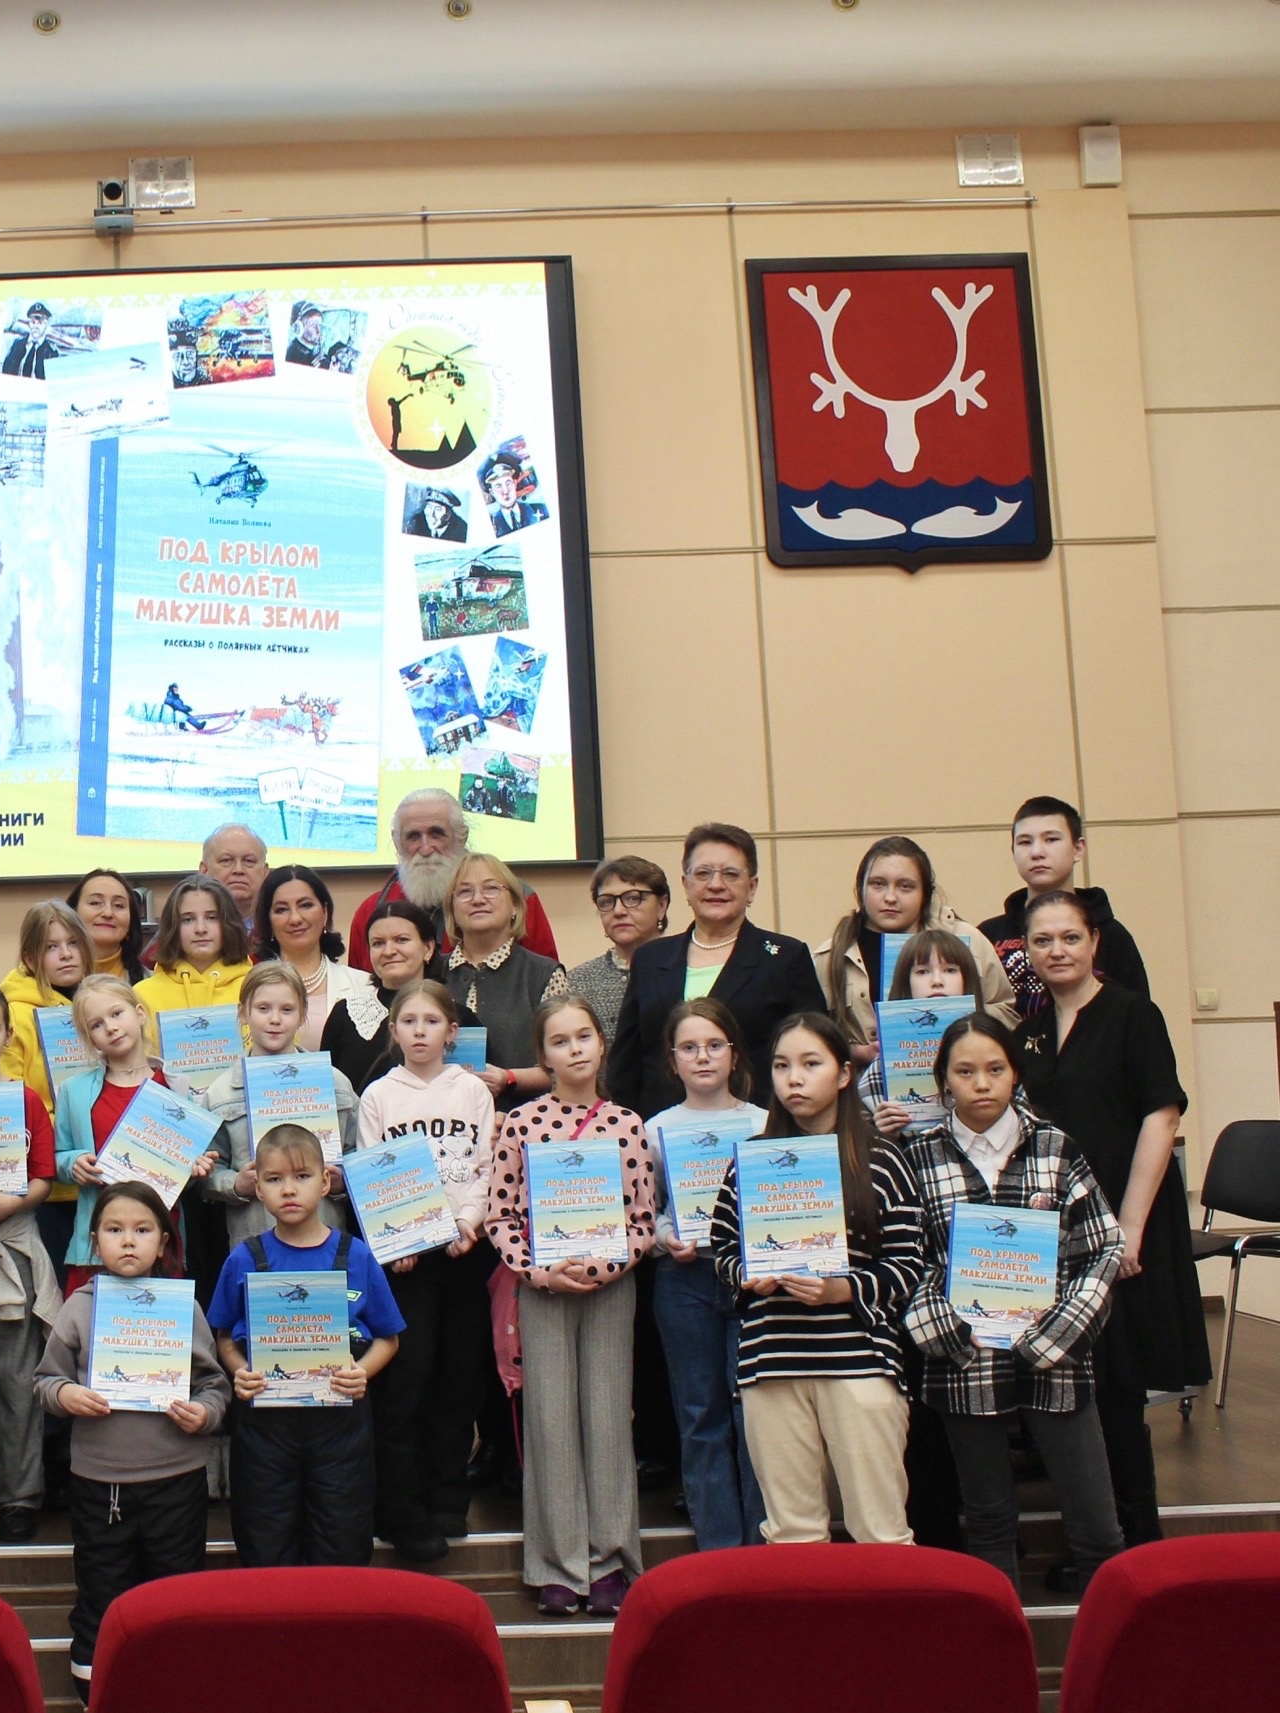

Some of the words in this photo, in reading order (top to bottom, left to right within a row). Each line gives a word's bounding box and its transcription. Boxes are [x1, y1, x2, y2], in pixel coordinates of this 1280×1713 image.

[159, 538, 209, 564] ПОД
[221, 541, 319, 568] КРЫЛОМ
[135, 598, 250, 626] МАКУШКА
[262, 605, 340, 631] ЗЕМЛИ
[164, 639, 206, 648] РАССКАЗЫ
[218, 641, 262, 651] ПОЛЯРНЫХ
[893, 1060, 933, 1069] МАКУШК
[382, 1118, 478, 1145] NOOPY
